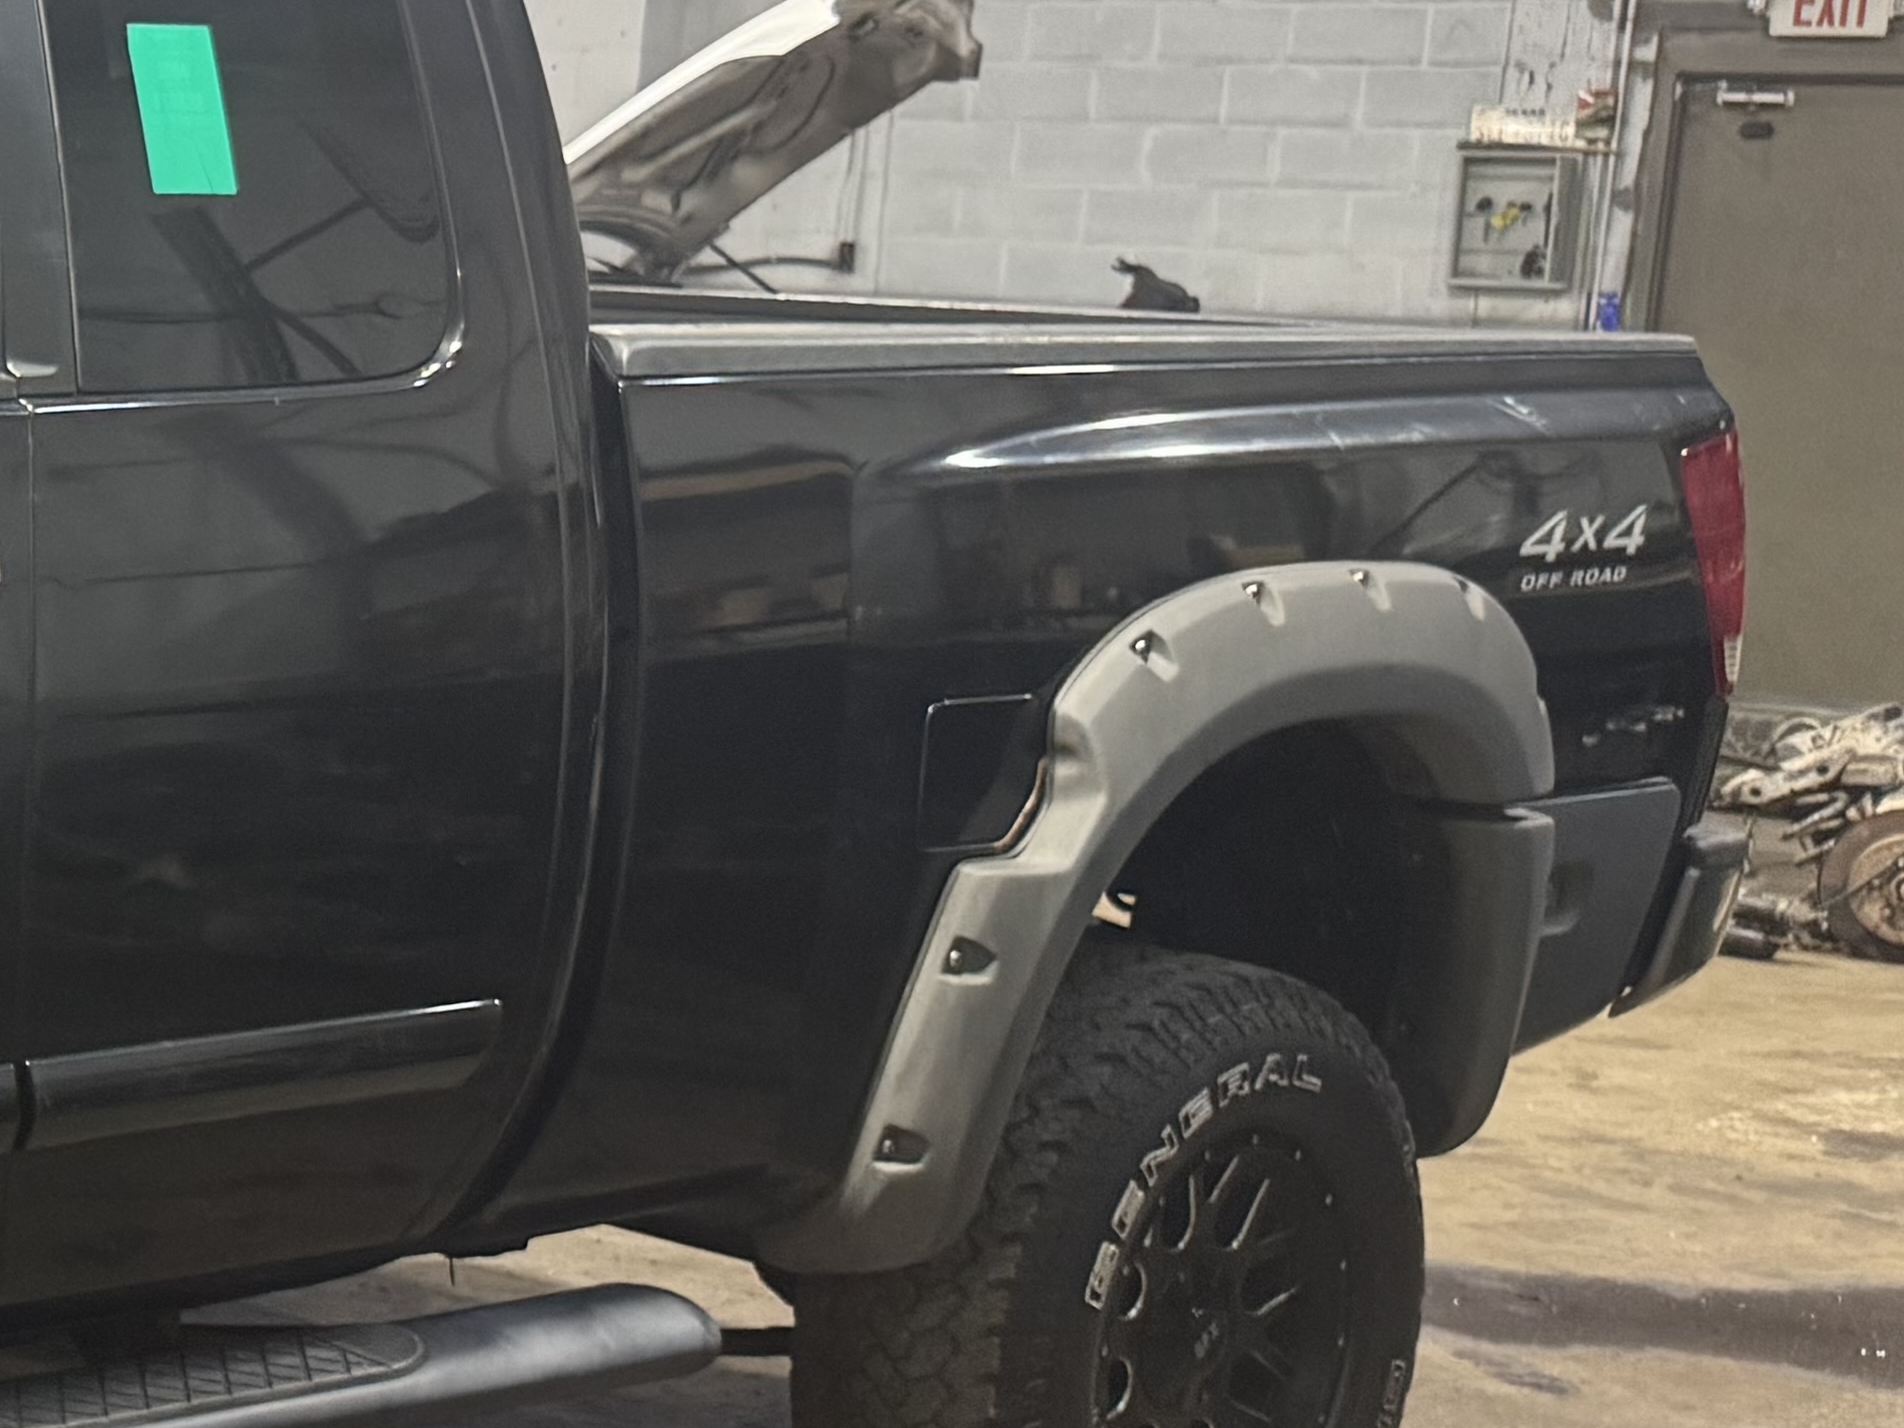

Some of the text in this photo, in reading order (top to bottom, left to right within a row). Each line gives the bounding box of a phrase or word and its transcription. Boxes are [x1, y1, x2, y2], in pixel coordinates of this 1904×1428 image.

[1519, 503, 1648, 563] 4x4
[1520, 565, 1628, 592] OFF ROAD
[1084, 1052, 1323, 1310] GENERAL
